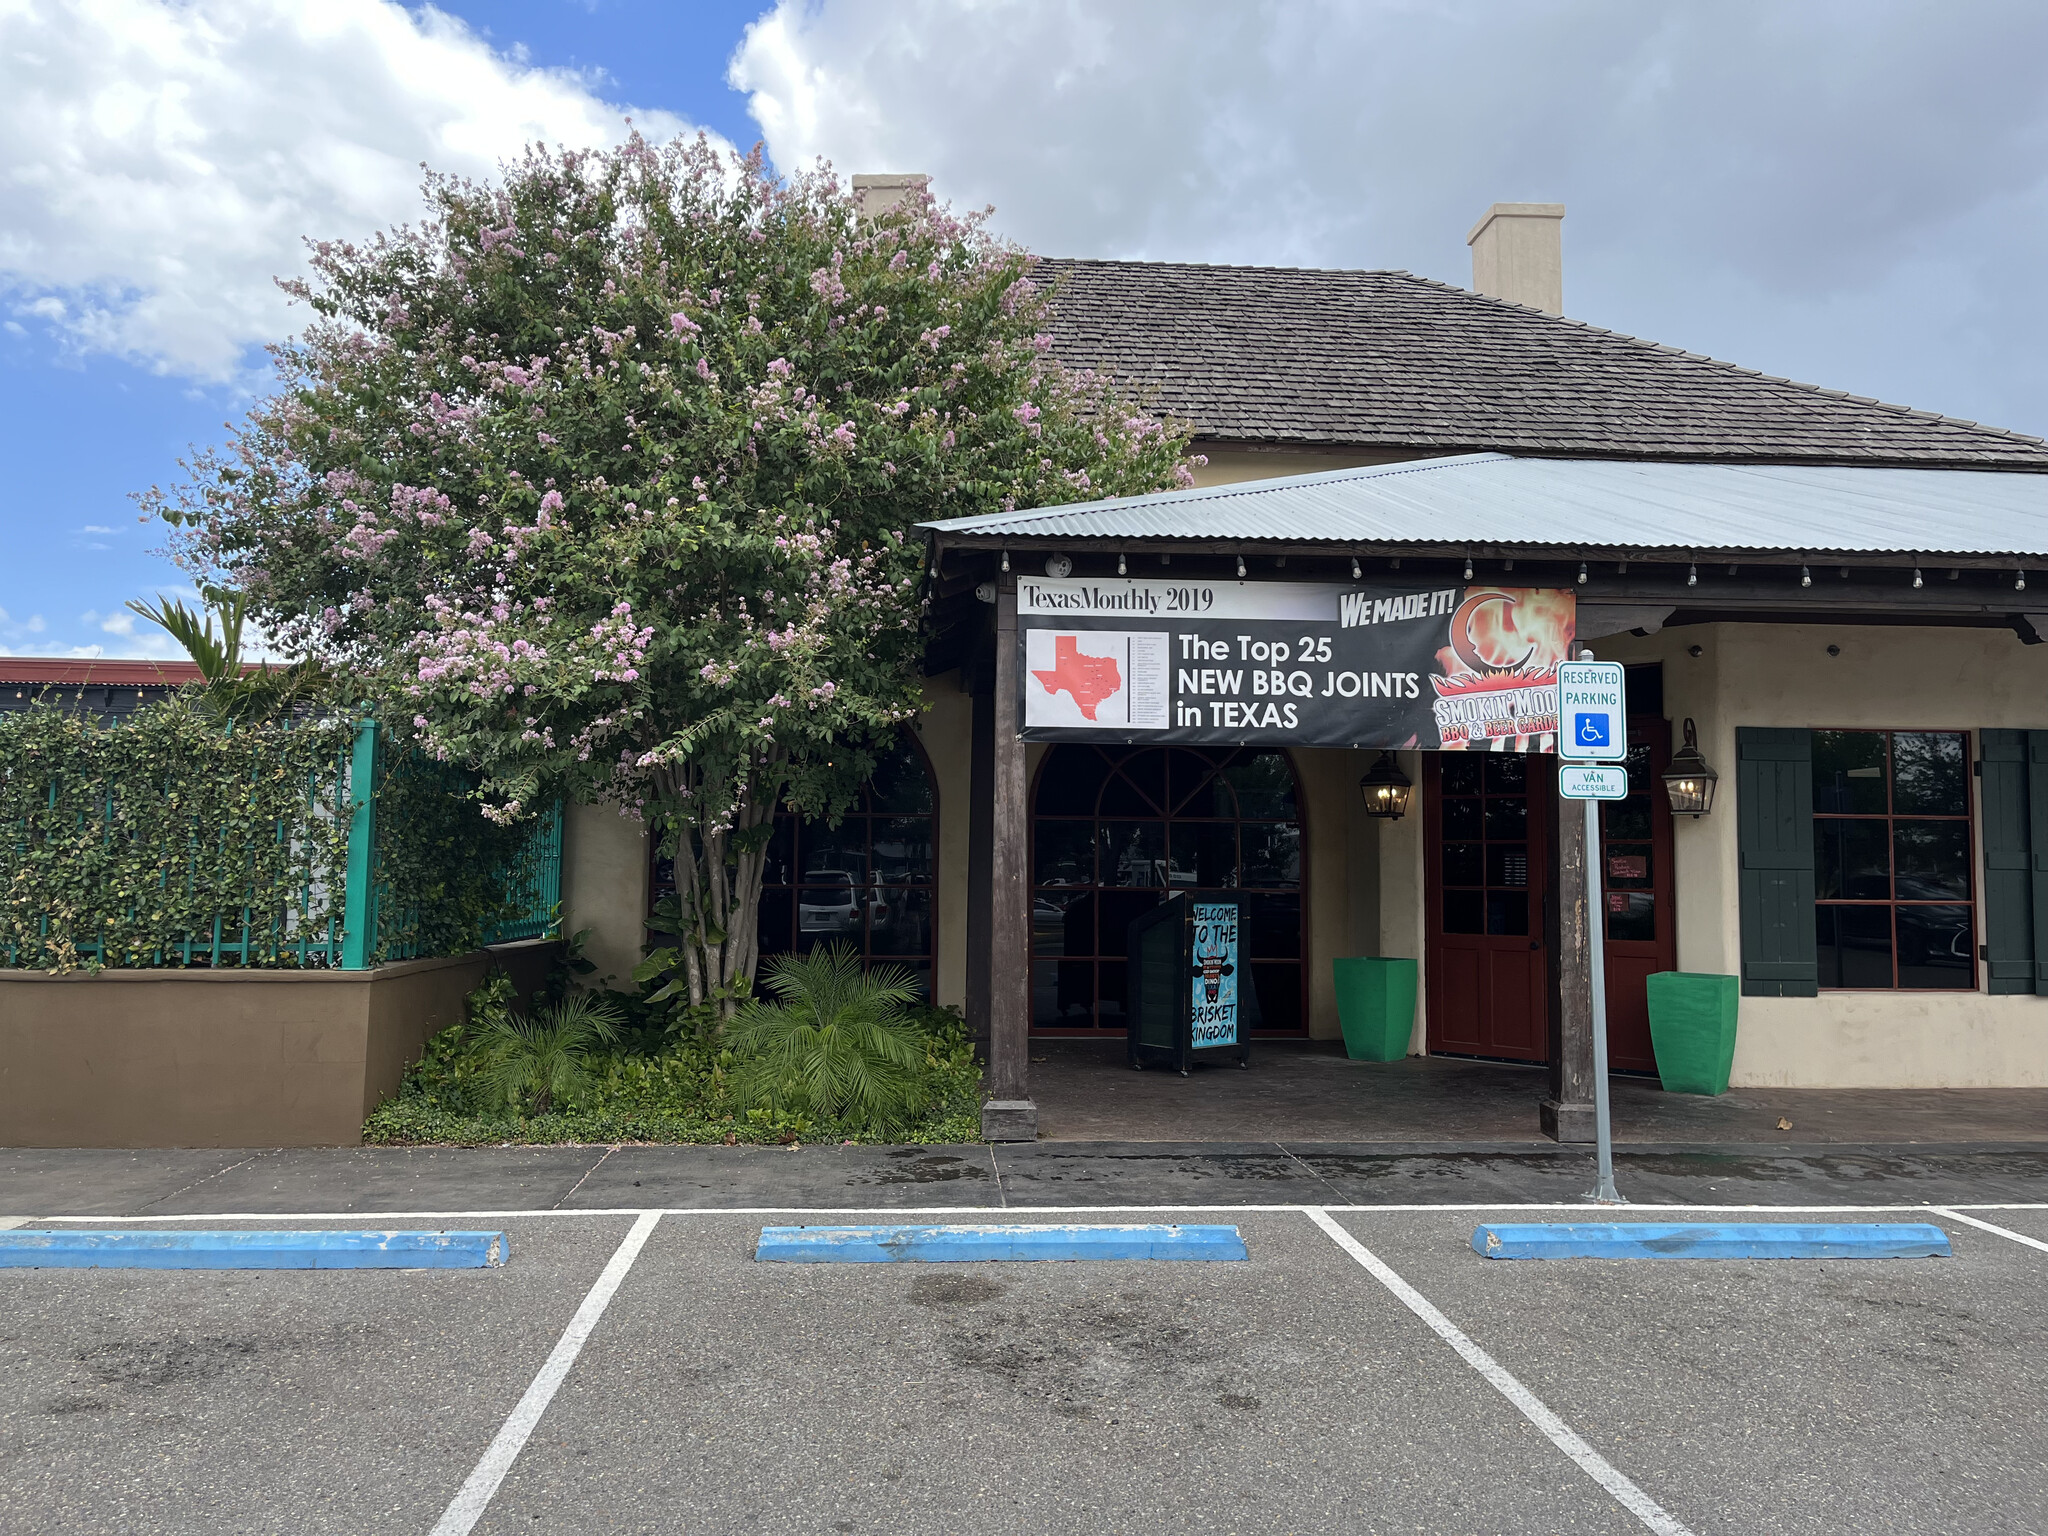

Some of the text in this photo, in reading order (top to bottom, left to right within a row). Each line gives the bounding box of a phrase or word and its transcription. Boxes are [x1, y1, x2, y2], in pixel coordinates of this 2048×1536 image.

[1166, 587, 1214, 612] 2019
[1178, 633, 1332, 668] The Top 25
[1178, 668, 1420, 699] NEW BBQ JOINTS
[1563, 671, 1618, 685] RESERVED
[1434, 688, 1558, 726] SMOKIN' MOO
[1566, 692, 1617, 705] PARKING
[1176, 700, 1299, 729] in TEXAS
[1441, 714, 1558, 742] BBQ & BEER GARDE
[1572, 784, 1616, 792] ACCESSIBLE
[1583, 773, 1604, 783] VAN
[1193, 924, 1237, 944] TO THE
[1192, 1003, 1236, 1024] BRISKET
